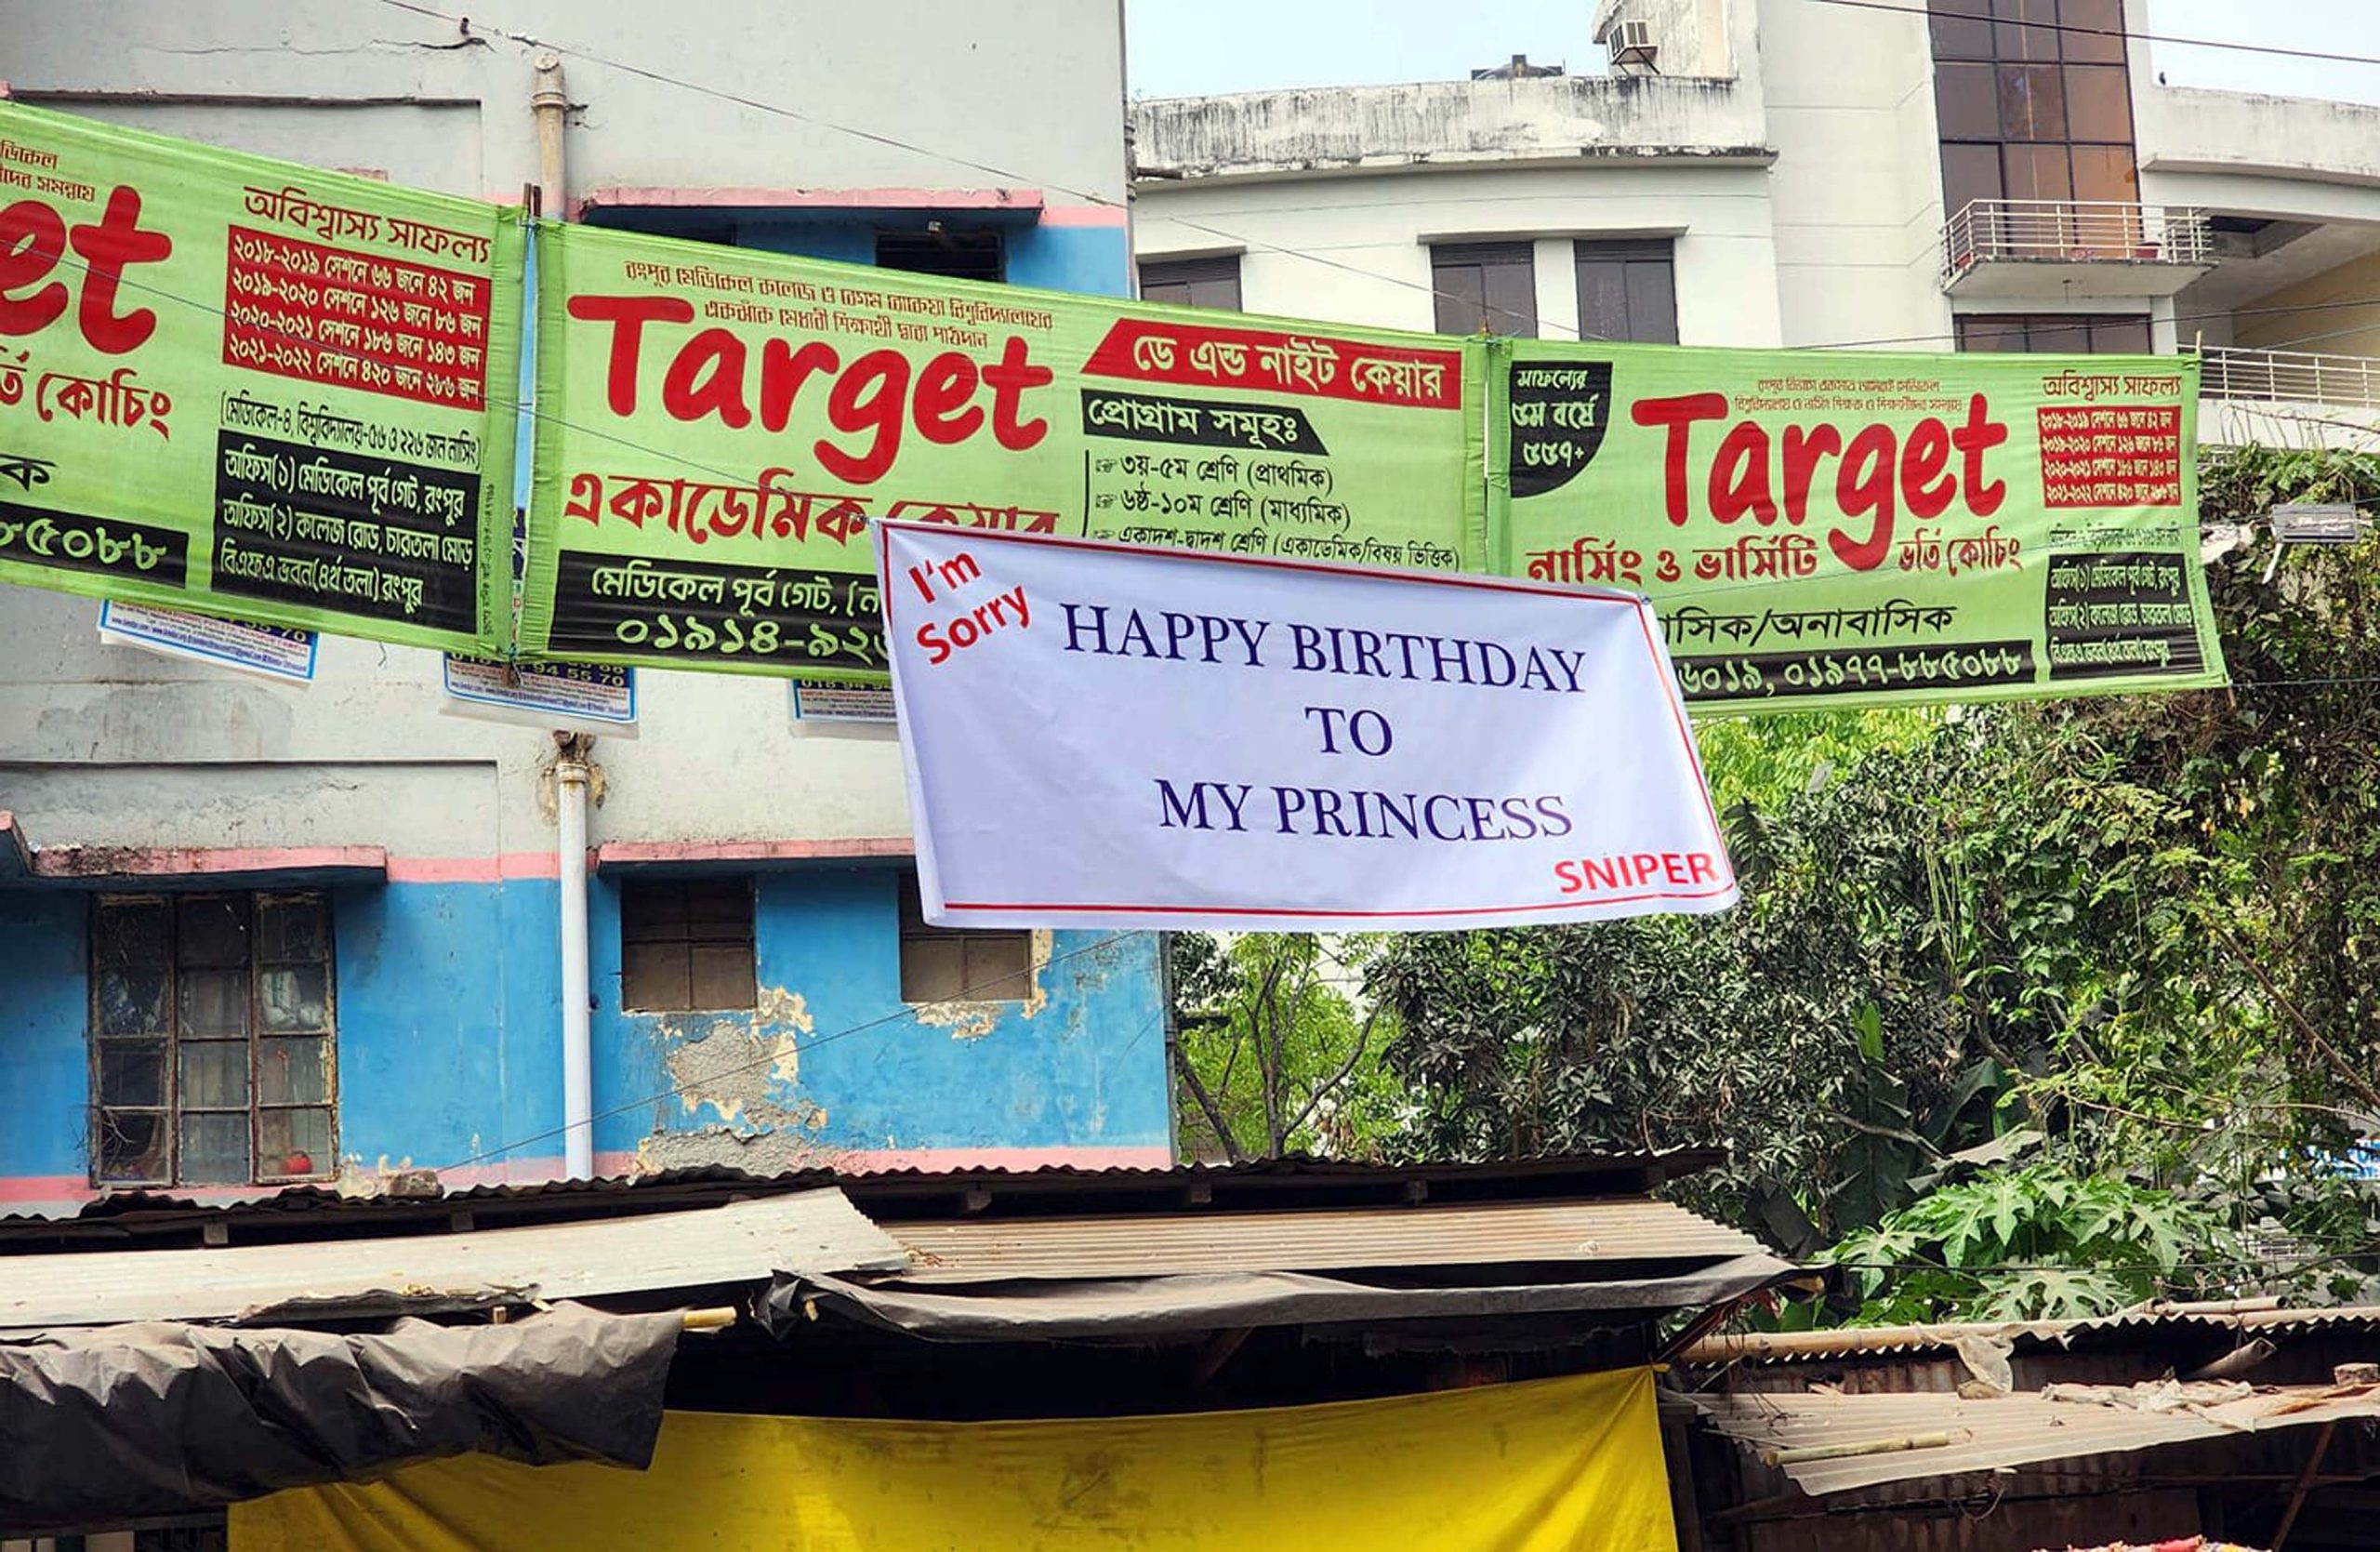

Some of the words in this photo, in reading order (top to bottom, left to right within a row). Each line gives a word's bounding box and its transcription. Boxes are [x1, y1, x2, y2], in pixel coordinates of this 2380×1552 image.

[244, 186, 381, 240] অবিশ্বাস্য
[387, 218, 492, 263] সাফল্য
[234, 234, 320, 274] ২০১৮-২০১৯
[324, 255, 369, 284] সেশনে
[396, 267, 425, 297] জনে
[429, 276, 448, 303] ৪২
[452, 280, 477, 306] জন
[677, 265, 754, 294] মেডিকেল
[231, 300, 314, 340] ২০২০-২০২১
[318, 318, 361, 347] সেশনে
[396, 333, 424, 361] জনে
[459, 344, 481, 371] জন
[233, 268, 319, 308] ২০১৯-২০২০
[323, 287, 367, 317] সেশনে
[371, 296, 400, 323] ১২৬
[403, 301, 431, 330] জনে
[460, 312, 483, 339] জন
[231, 333, 312, 374] ২০২১-২০২২
[316, 351, 359, 378] সেশনে
[362, 360, 390, 388] ৪২০
[394, 365, 422, 392] জনে
[457, 378, 480, 402] জন
[567, 295, 1053, 484] Target
[1133, 335, 1177, 372] ডে
[1189, 339, 1248, 378] এন্ড
[1255, 336, 1340, 392] নাইট
[1351, 357, 1445, 401] কেয়ার
[1517, 368, 1588, 391] সাফল্যের
[2042, 370, 2120, 401] অবিশ্বাস্য
[2123, 376, 2182, 395] সাফল্য
[36, 367, 172, 442] কোচিং
[1088, 396, 1201, 435] প্রোগ্রাম
[1208, 406, 1299, 448] সমূহঃ
[1550, 393, 1600, 430] বর্ষে
[224, 443, 296, 494] অফিস(১)
[298, 457, 364, 500] মেডিকেল
[365, 467, 392, 514] পূর্ব
[391, 473, 421, 515] গেট,
[425, 484, 465, 526] রংপুর
[563, 467, 874, 547] একাডেমিক
[1120, 454, 1190, 480] ৩য়-৫ম
[1197, 454, 1239, 483] শ্রেণি
[1247, 458, 1333, 497] (প্রাথমিক)
[1120, 482, 1204, 515] ৬ষ্ঠ-১০ম
[1210, 489, 1253, 519] শ্রেণি
[1261, 496, 1351, 533] (মাধ্যমিক)
[1631, 392, 2008, 571] Target
[222, 492, 293, 541] অফিস(২)
[296, 511, 345, 546] কলেজ
[348, 521, 383, 555] রোড,
[386, 526, 439, 562] চারতলা
[442, 537, 473, 571] মোড়
[1231, 526, 1268, 555] শ্রেণি
[1526, 537, 1643, 586] নার্সিং
[1656, 550, 1682, 583] ও
[1692, 534, 1818, 581] ভার্সিটি
[1897, 527, 1941, 571] ভর্তি
[1947, 525, 2023, 577] কোচিং
[219, 537, 276, 579] বিএফএ
[343, 566, 379, 603] তলা)
[382, 574, 423, 615] রংপুর
[590, 559, 725, 605] মেডিকেল
[733, 569, 776, 617] পূর্ব
[781, 576, 838, 616] গেট,
[917, 585, 1030, 666] Sorry
[1059, 603, 1271, 668] HAPPY
[1286, 623, 1587, 694] BIRTHDAY
[1784, 648, 2022, 689] ০১৯৭৭-৮৮৫০৮৮
[1304, 706, 1395, 757] TO
[1153, 777, 1253, 833] MY
[1270, 786, 1574, 842] PRINCESS
[1554, 852, 1720, 894] SNIPER
